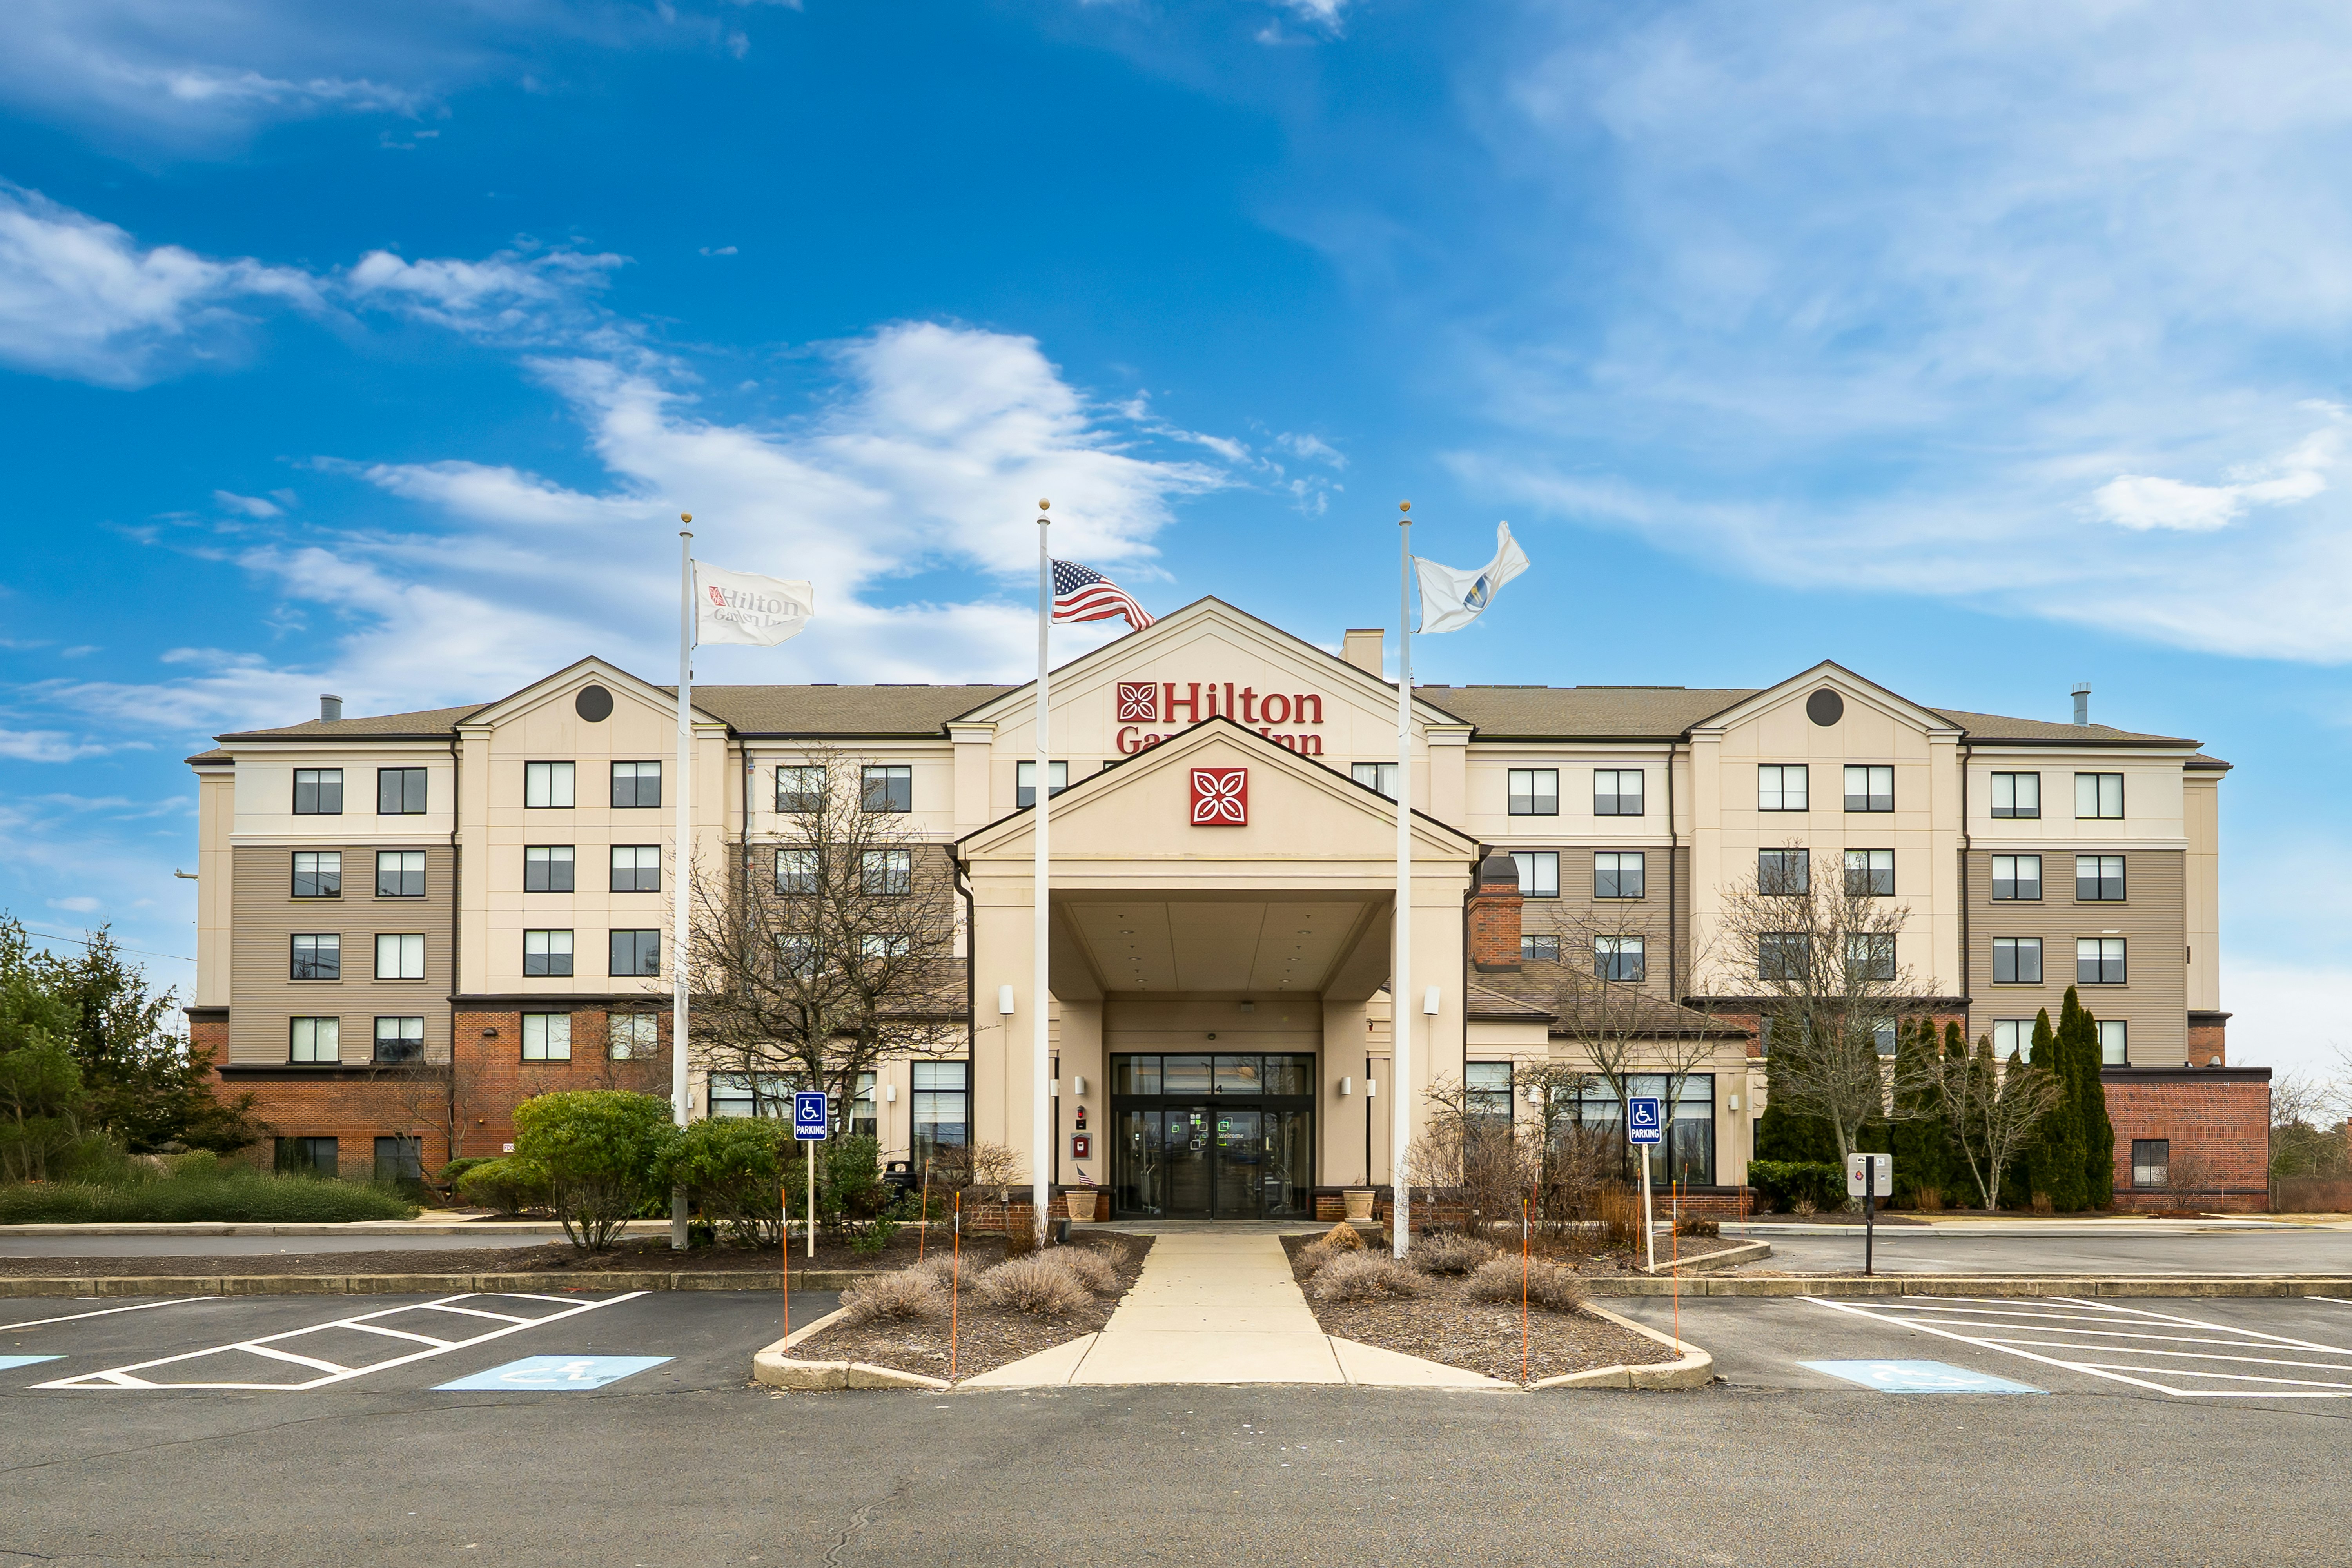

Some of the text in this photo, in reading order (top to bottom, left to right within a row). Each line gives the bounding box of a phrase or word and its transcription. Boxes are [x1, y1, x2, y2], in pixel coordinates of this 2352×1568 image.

[720, 587, 799, 617] Hilton
[1163, 683, 1324, 723] Hilton
[1216, 1085, 1222, 1093] 4
[797, 1125, 824, 1134] PARKING
[1632, 1129, 1659, 1138] PARKING
